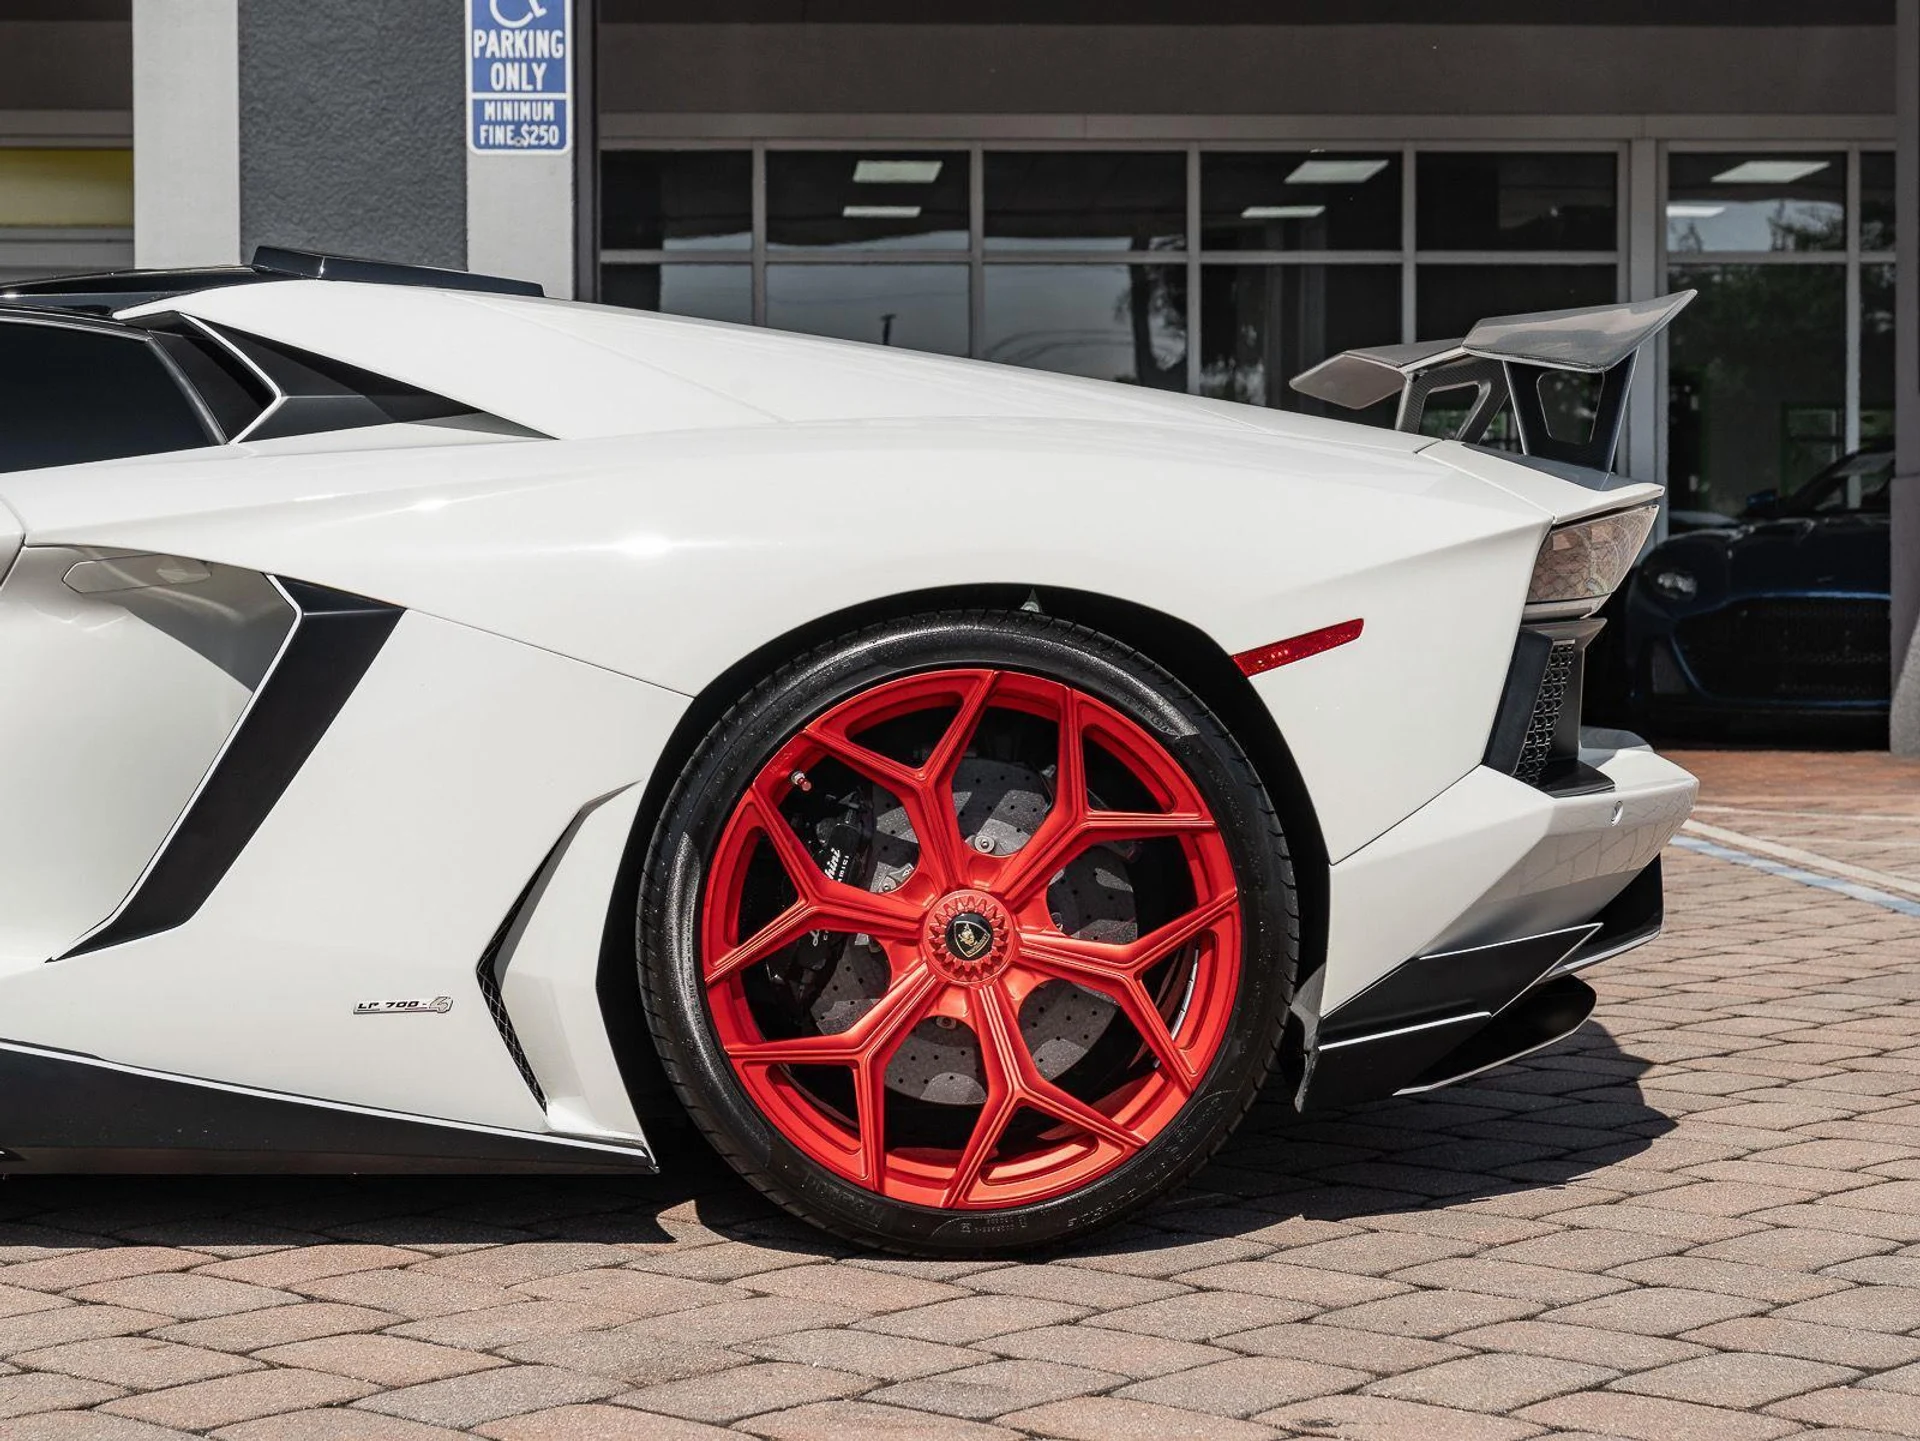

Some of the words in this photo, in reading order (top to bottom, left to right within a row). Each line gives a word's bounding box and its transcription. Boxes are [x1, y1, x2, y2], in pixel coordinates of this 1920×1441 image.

[473, 29, 564, 58] PARKING
[490, 62, 547, 91] ONLY
[484, 101, 555, 122] MINIMUM
[480, 125, 516, 146] FINE
[520, 123, 560, 148] $250
[358, 1001, 380, 1010] LP
